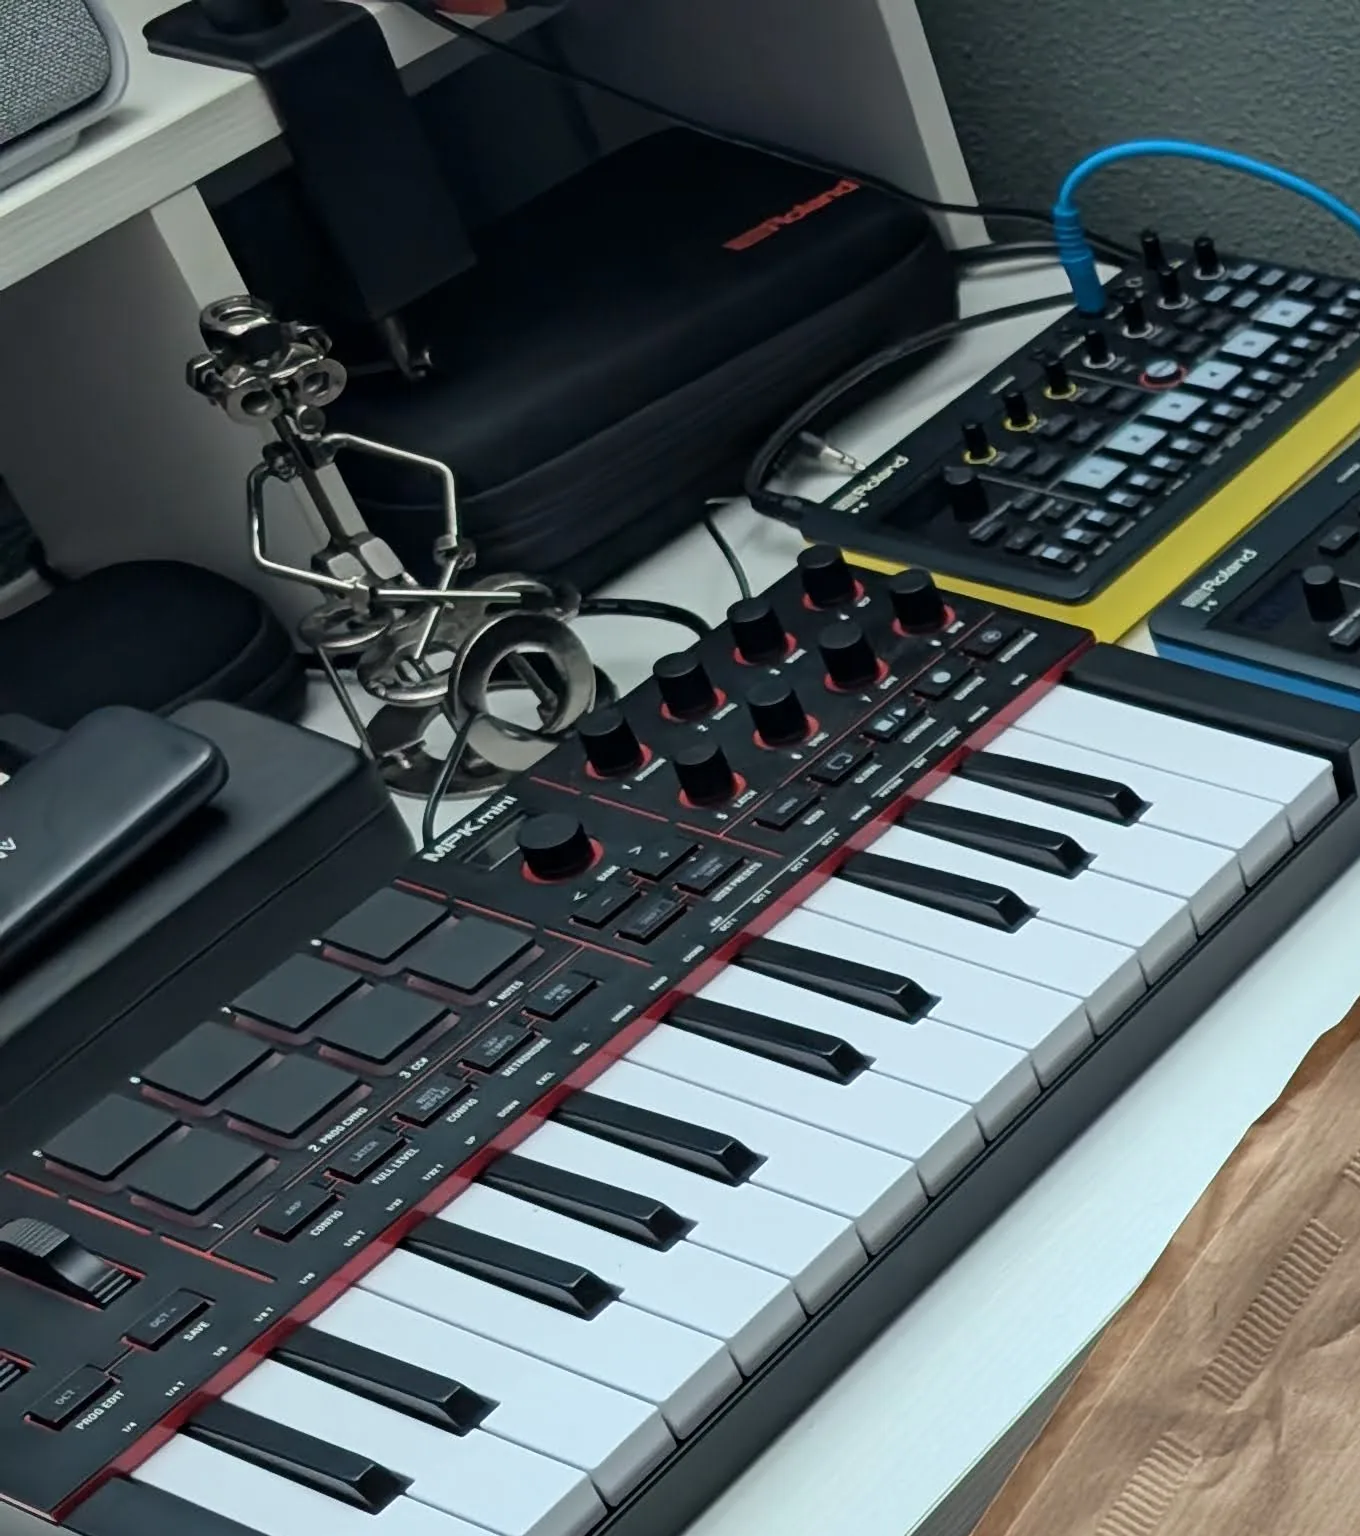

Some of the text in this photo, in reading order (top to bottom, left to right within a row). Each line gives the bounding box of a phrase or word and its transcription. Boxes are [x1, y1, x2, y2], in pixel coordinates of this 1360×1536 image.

[422, 795, 519, 864] MPK mini
[495, 979, 525, 1003] NOTES
[446, 1098, 480, 1124] CONFIG
[371, 1147, 421, 1185] FULL LEVEL
[309, 1209, 344, 1237] CONFIG
[183, 1320, 211, 1343] SAVE
[75, 1389, 126, 1431] PROG EDIT
